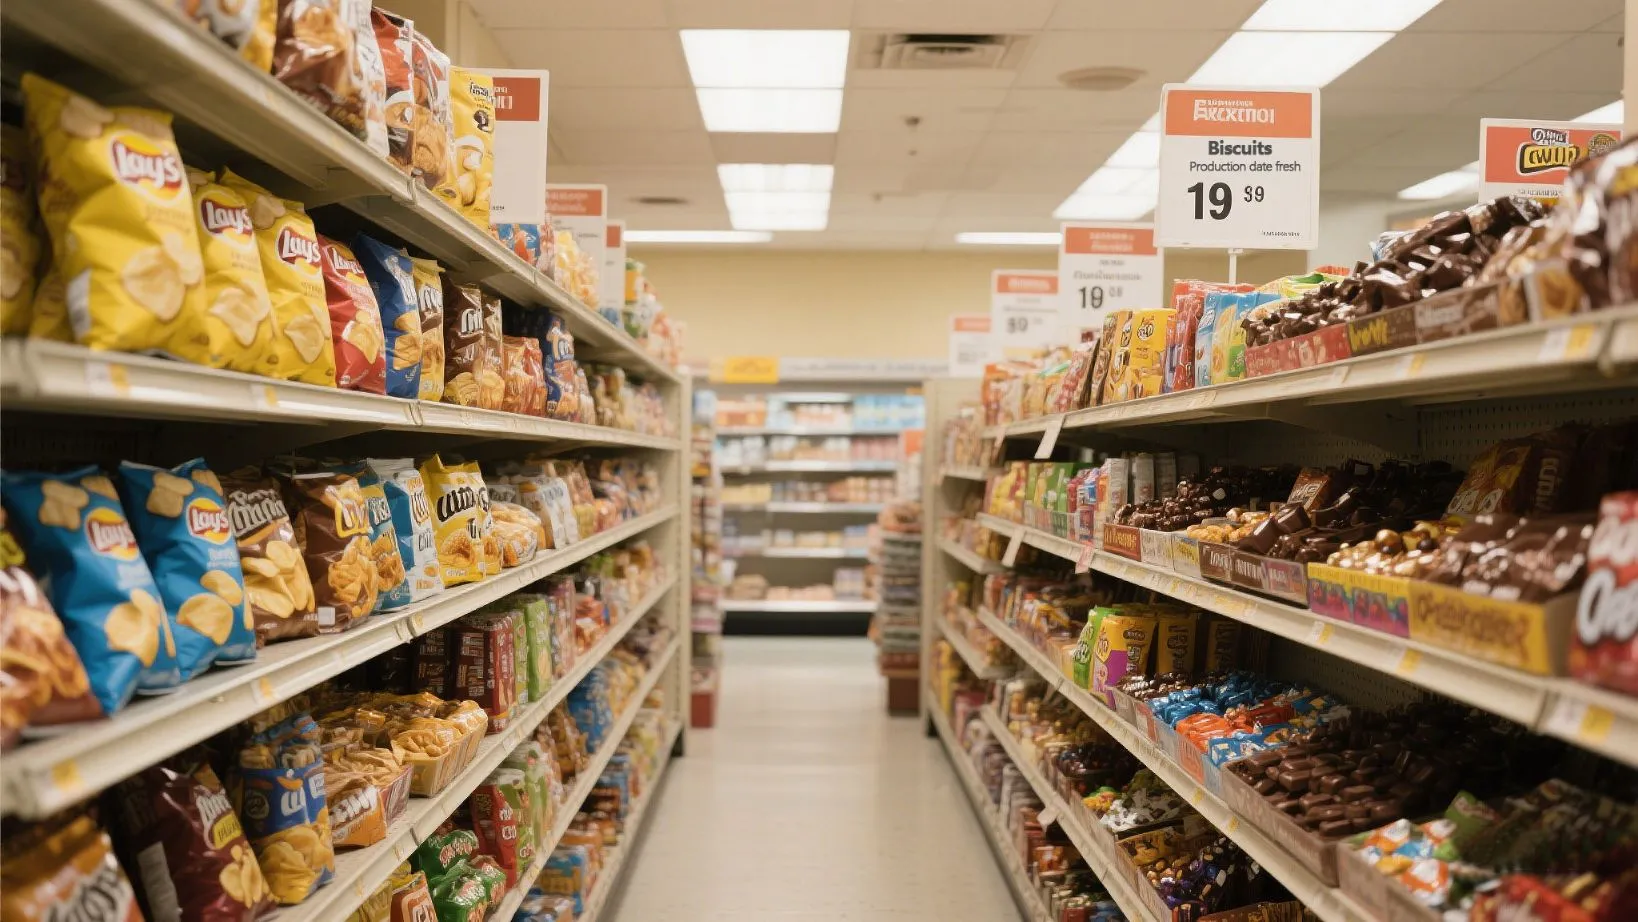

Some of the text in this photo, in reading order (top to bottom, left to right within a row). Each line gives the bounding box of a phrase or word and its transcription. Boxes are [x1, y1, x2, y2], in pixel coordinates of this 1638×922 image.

[1208, 139, 1273, 156] Biscuits
[1189, 160, 1302, 172] Production date fresh
[1187, 181, 1233, 221] 19
